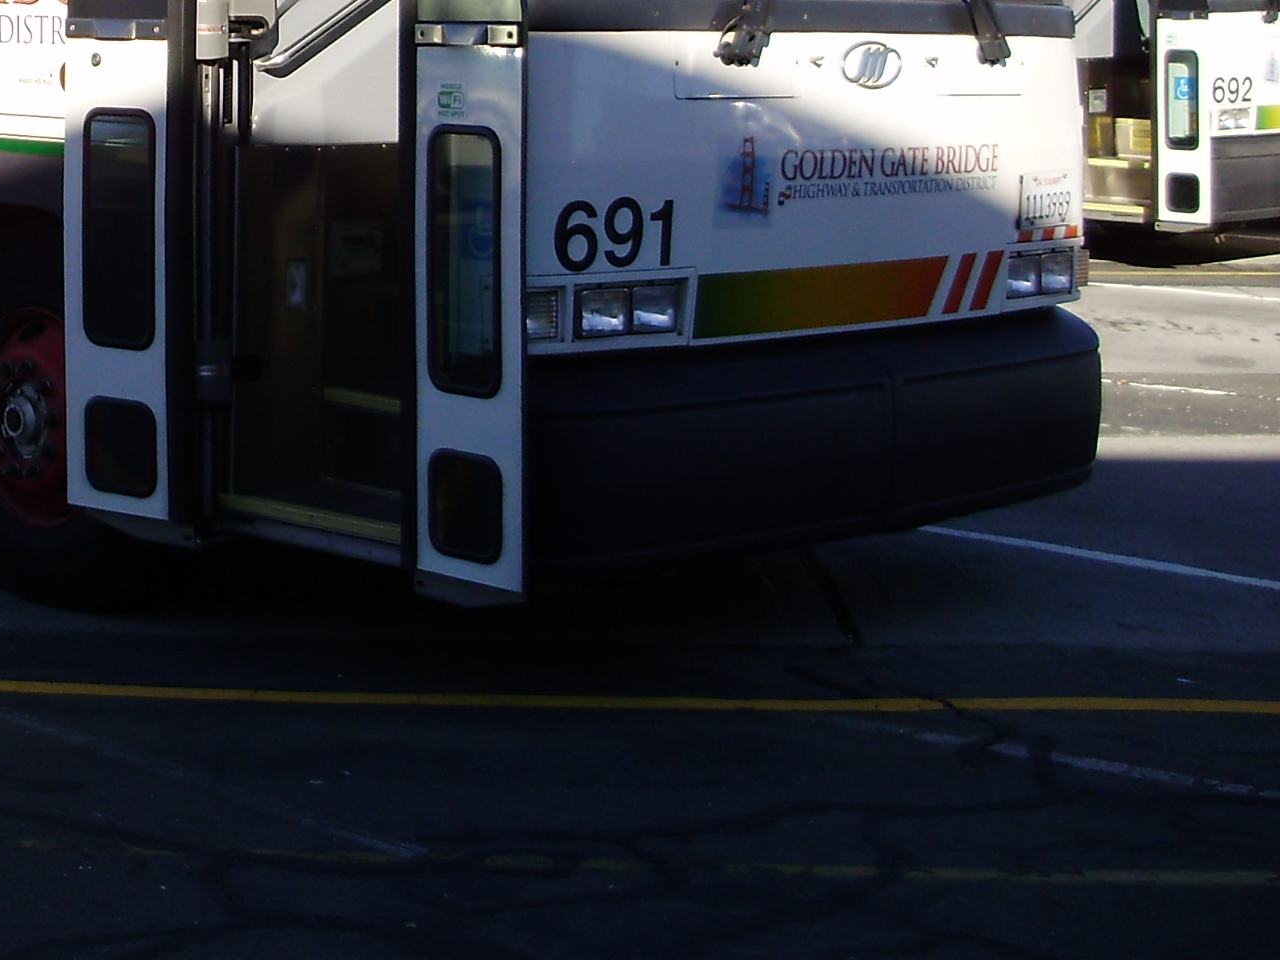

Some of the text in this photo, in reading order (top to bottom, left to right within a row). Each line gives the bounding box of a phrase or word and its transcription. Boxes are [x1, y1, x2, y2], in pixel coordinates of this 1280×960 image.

[1212, 76, 1253, 104] 692
[781, 144, 998, 181] GOLDEN GATE BRIDGE
[793, 175, 997, 199] HIGHWAY & TRANSPORTATION DISTRICT
[1024, 190, 1071, 221] 1113989
[554, 196, 674, 272] 691
